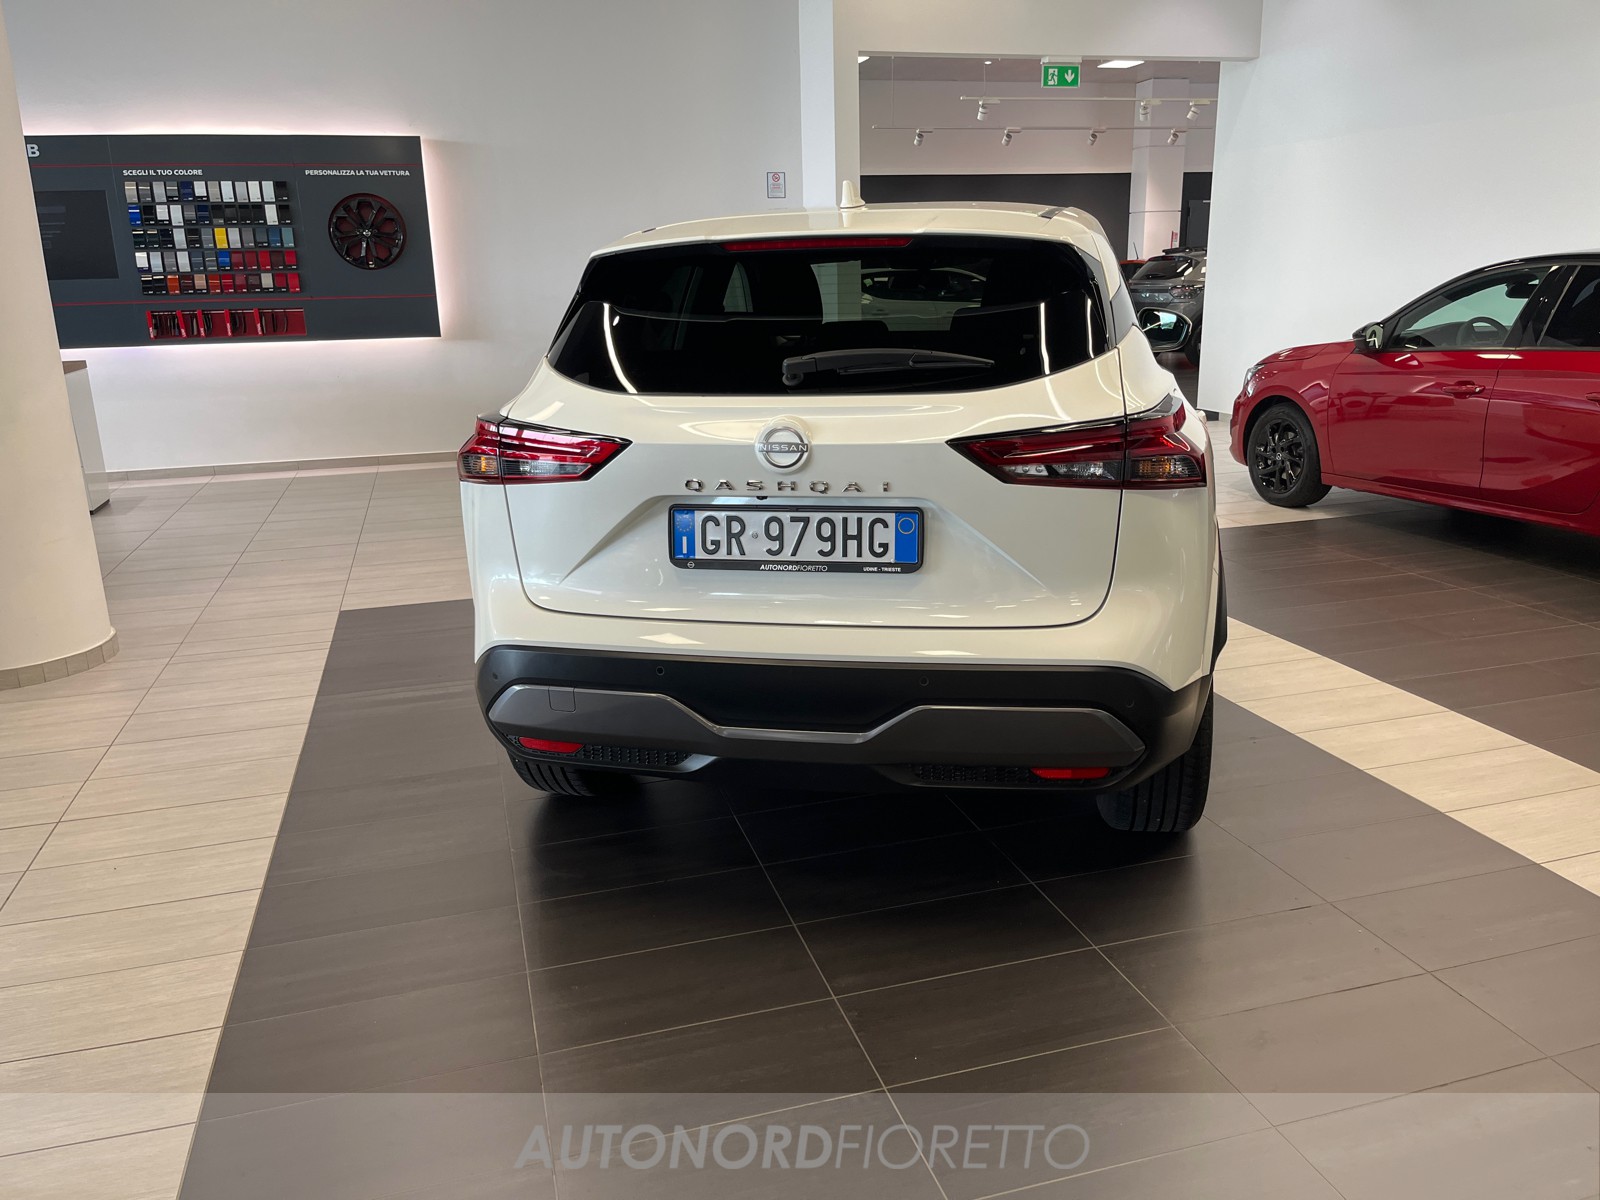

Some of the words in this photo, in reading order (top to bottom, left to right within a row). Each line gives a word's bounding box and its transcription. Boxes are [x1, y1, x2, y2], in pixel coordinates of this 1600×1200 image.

[379, 169, 411, 177] VETTURA
[757, 443, 808, 452] NISSAN
[684, 479, 890, 494] QASHQAI
[700, 515, 747, 556] GR
[763, 515, 890, 558] 979HG
[759, 563, 828, 572] AUTONORDFIORETTO
